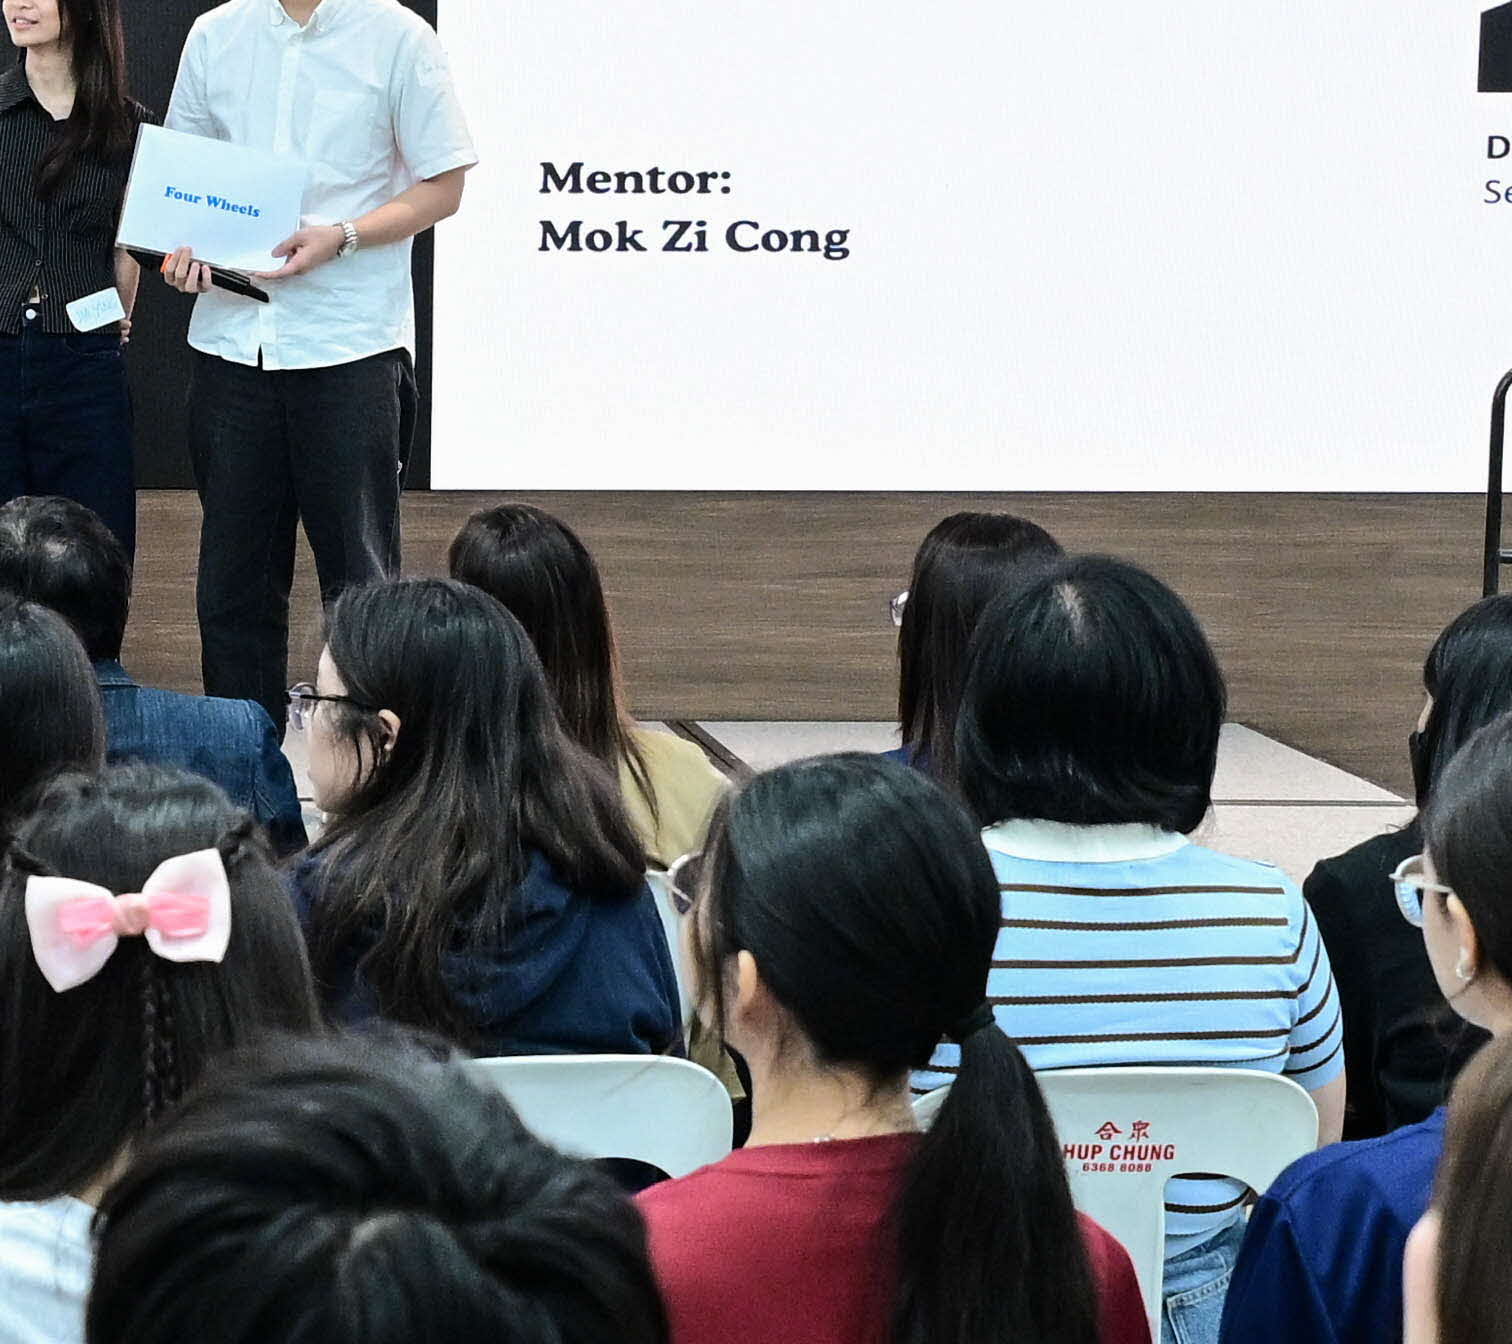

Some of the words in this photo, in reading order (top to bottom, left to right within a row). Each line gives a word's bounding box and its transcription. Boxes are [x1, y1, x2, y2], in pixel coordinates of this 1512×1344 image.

[538, 161, 731, 195] Mentor:
[165, 186, 202, 203] Four
[206, 195, 260, 217] Wheels
[538, 220, 648, 253] Mok
[661, 219, 709, 253] Zi
[725, 220, 851, 261] Cong
[1063, 1144, 1102, 1160] HUP
[1110, 1144, 1175, 1160] CHUNG
[1083, 1163, 1114, 1172] 6368
[1120, 1163, 1152, 1172] 8088
